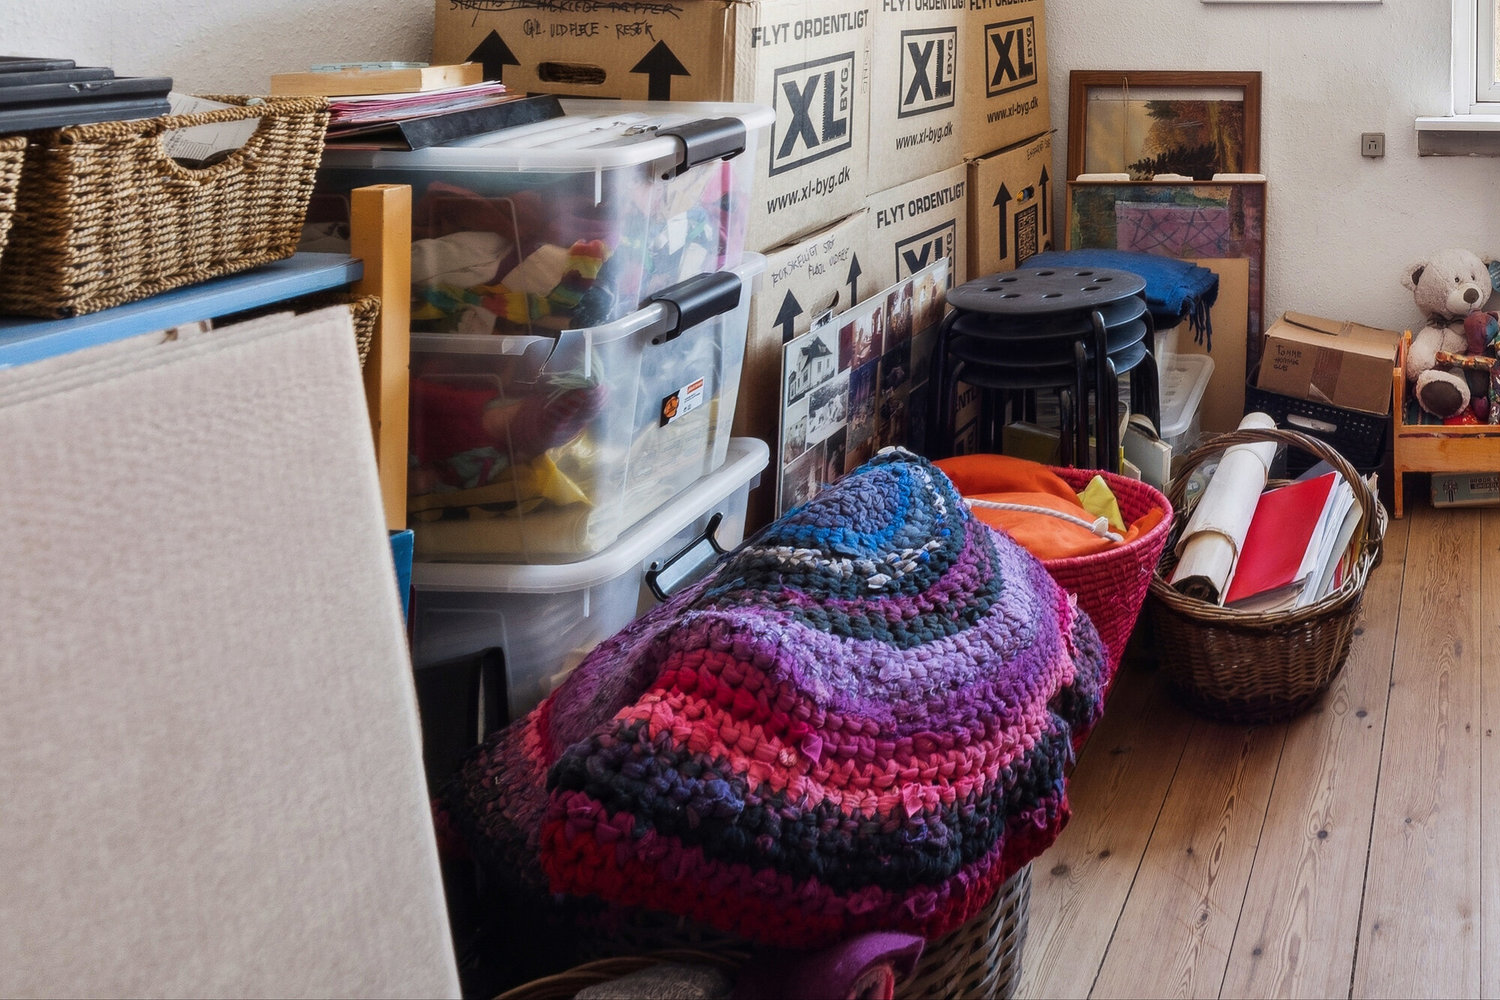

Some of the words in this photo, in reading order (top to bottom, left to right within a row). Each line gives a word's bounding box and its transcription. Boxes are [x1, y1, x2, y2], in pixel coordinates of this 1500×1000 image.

[751, 22, 790, 48] FLYT
[794, 9, 869, 41] ORDENTLIGT
[903, 39, 953, 105] XL
[990, 28, 1034, 87] XL
[840, 66, 849, 112] BYG
[986, 96, 1039, 123] www.xl-byg.dk
[776, 70, 848, 160] XL
[895, 121, 954, 150] www.xl-byg.dk
[767, 165, 851, 215] www.xl-byg.dk
[877, 203, 905, 229] FLYT
[908, 181, 966, 218] ORDENTLIGT
